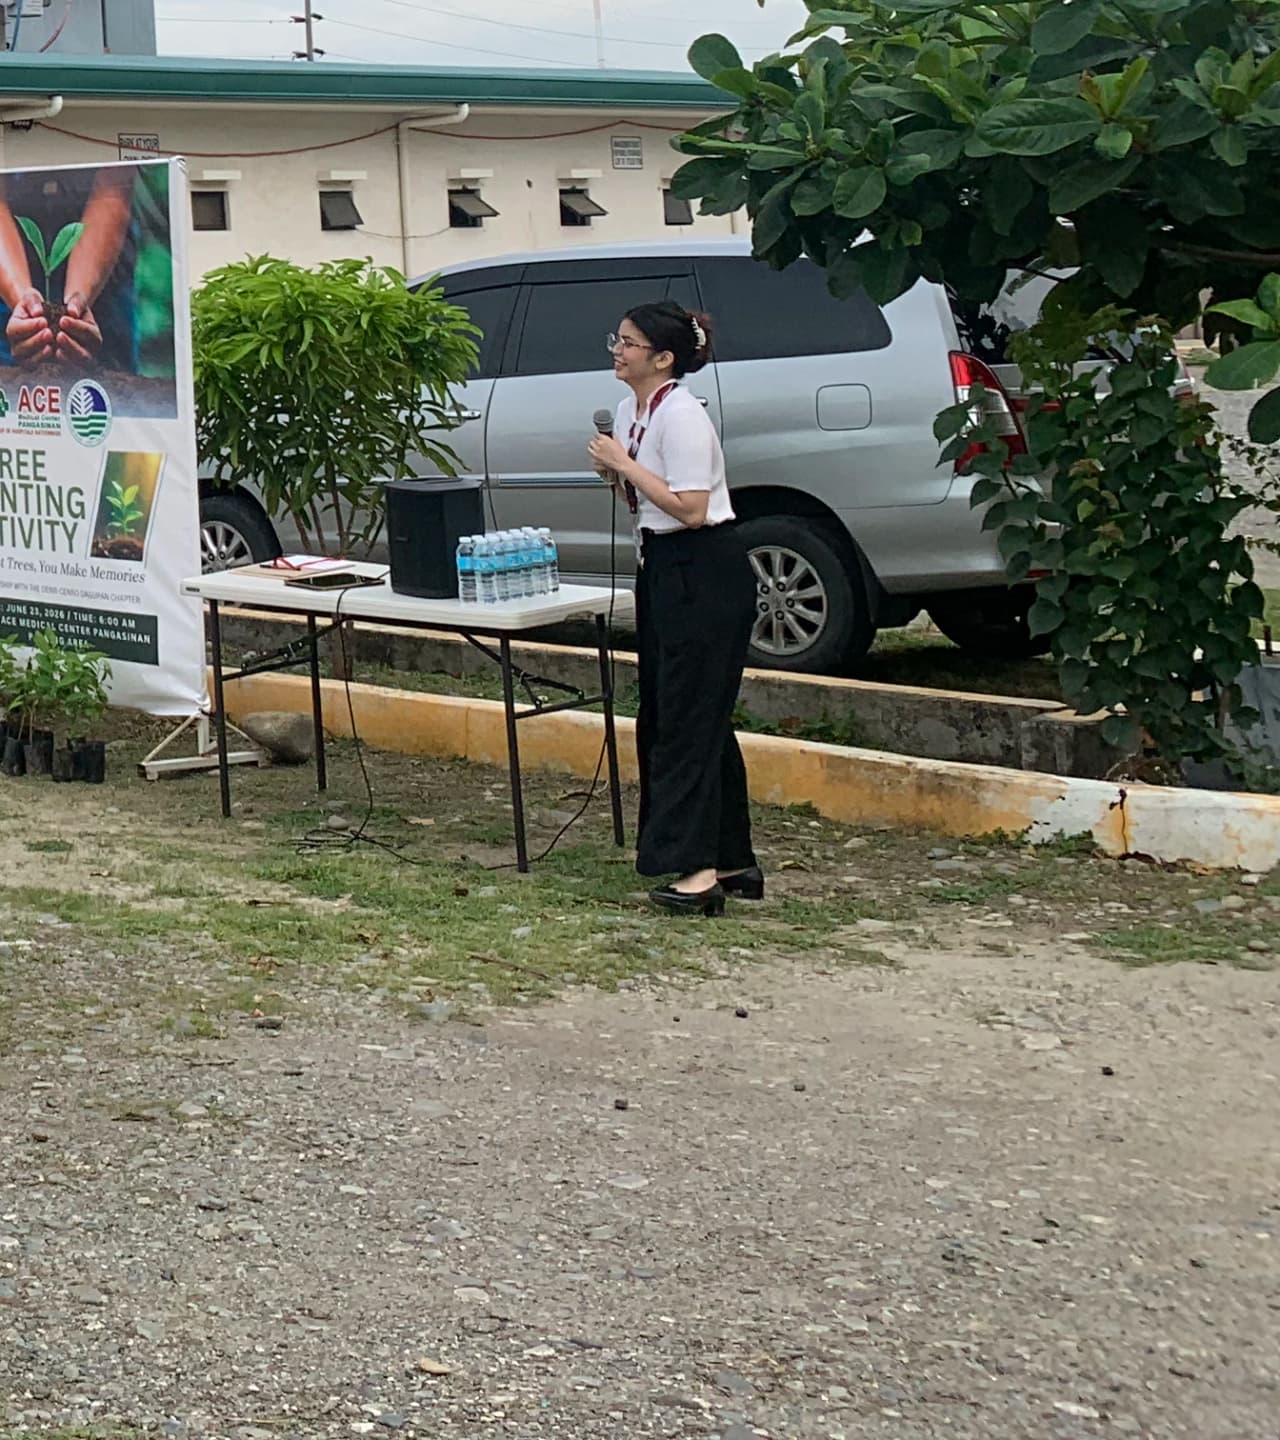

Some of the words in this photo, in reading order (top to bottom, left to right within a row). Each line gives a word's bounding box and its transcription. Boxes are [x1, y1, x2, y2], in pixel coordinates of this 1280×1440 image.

[18, 388, 60, 413] ACE
[18, 421, 61, 429] PANGASINAN
[7, 558, 37, 573] Trees,
[40, 560, 58, 575] You
[60, 562, 88, 578] Make
[90, 565, 145, 584] Memories
[6, 603, 27, 615] JUNE
[73, 611, 97, 623] TIME:
[99, 615, 119, 626] 6:00
[121, 618, 135, 628] AM
[1, 616, 17, 626] ACE
[58, 623, 91, 636] CENTER
[93, 627, 151, 644] PANGASINAN
